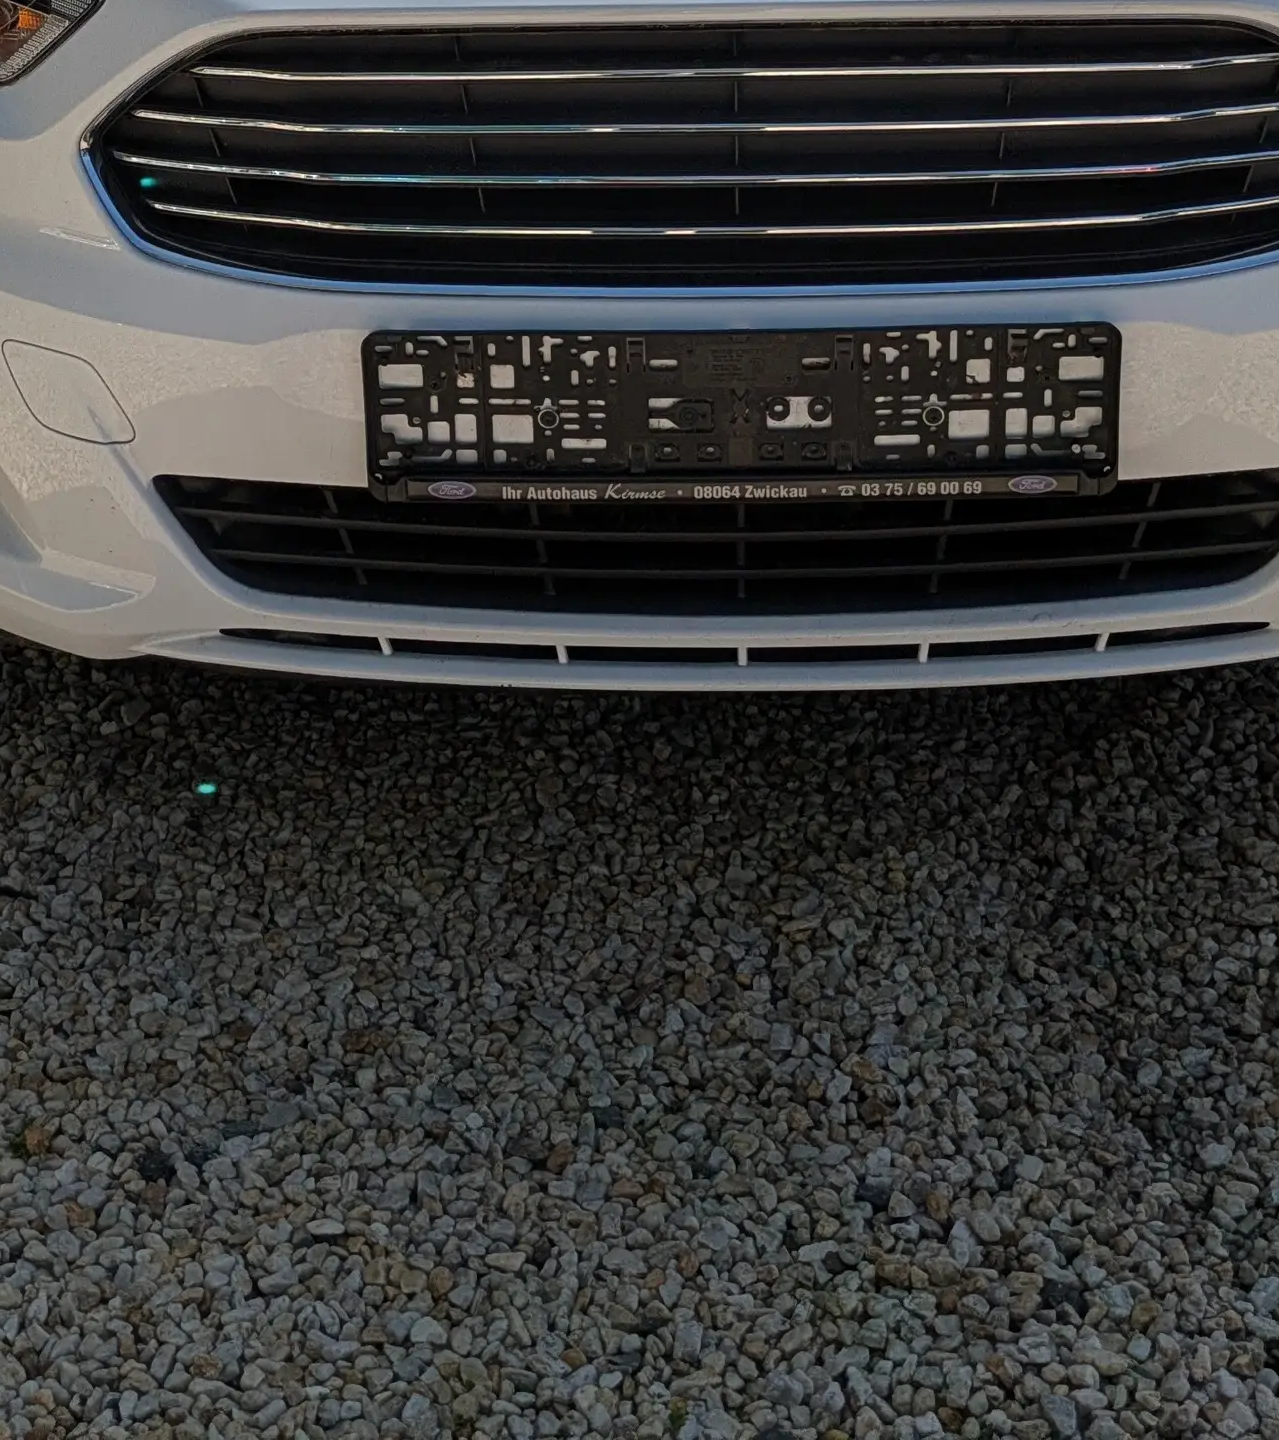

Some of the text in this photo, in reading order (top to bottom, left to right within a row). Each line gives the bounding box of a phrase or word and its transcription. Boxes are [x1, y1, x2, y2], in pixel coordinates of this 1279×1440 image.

[438, 484, 465, 496] Ford
[502, 486, 523, 500] Ihr
[527, 486, 598, 500] Autohaus
[604, 483, 666, 500] Kirmse
[693, 485, 741, 499] 08064
[744, 484, 808, 498] Zwickau
[861, 483, 880, 496] 03
[885, 482, 903, 496] 75
[917, 481, 936, 495] 69
[940, 481, 959, 495] 00
[963, 480, 982, 494] 69
[1019, 478, 1046, 490] Ford
